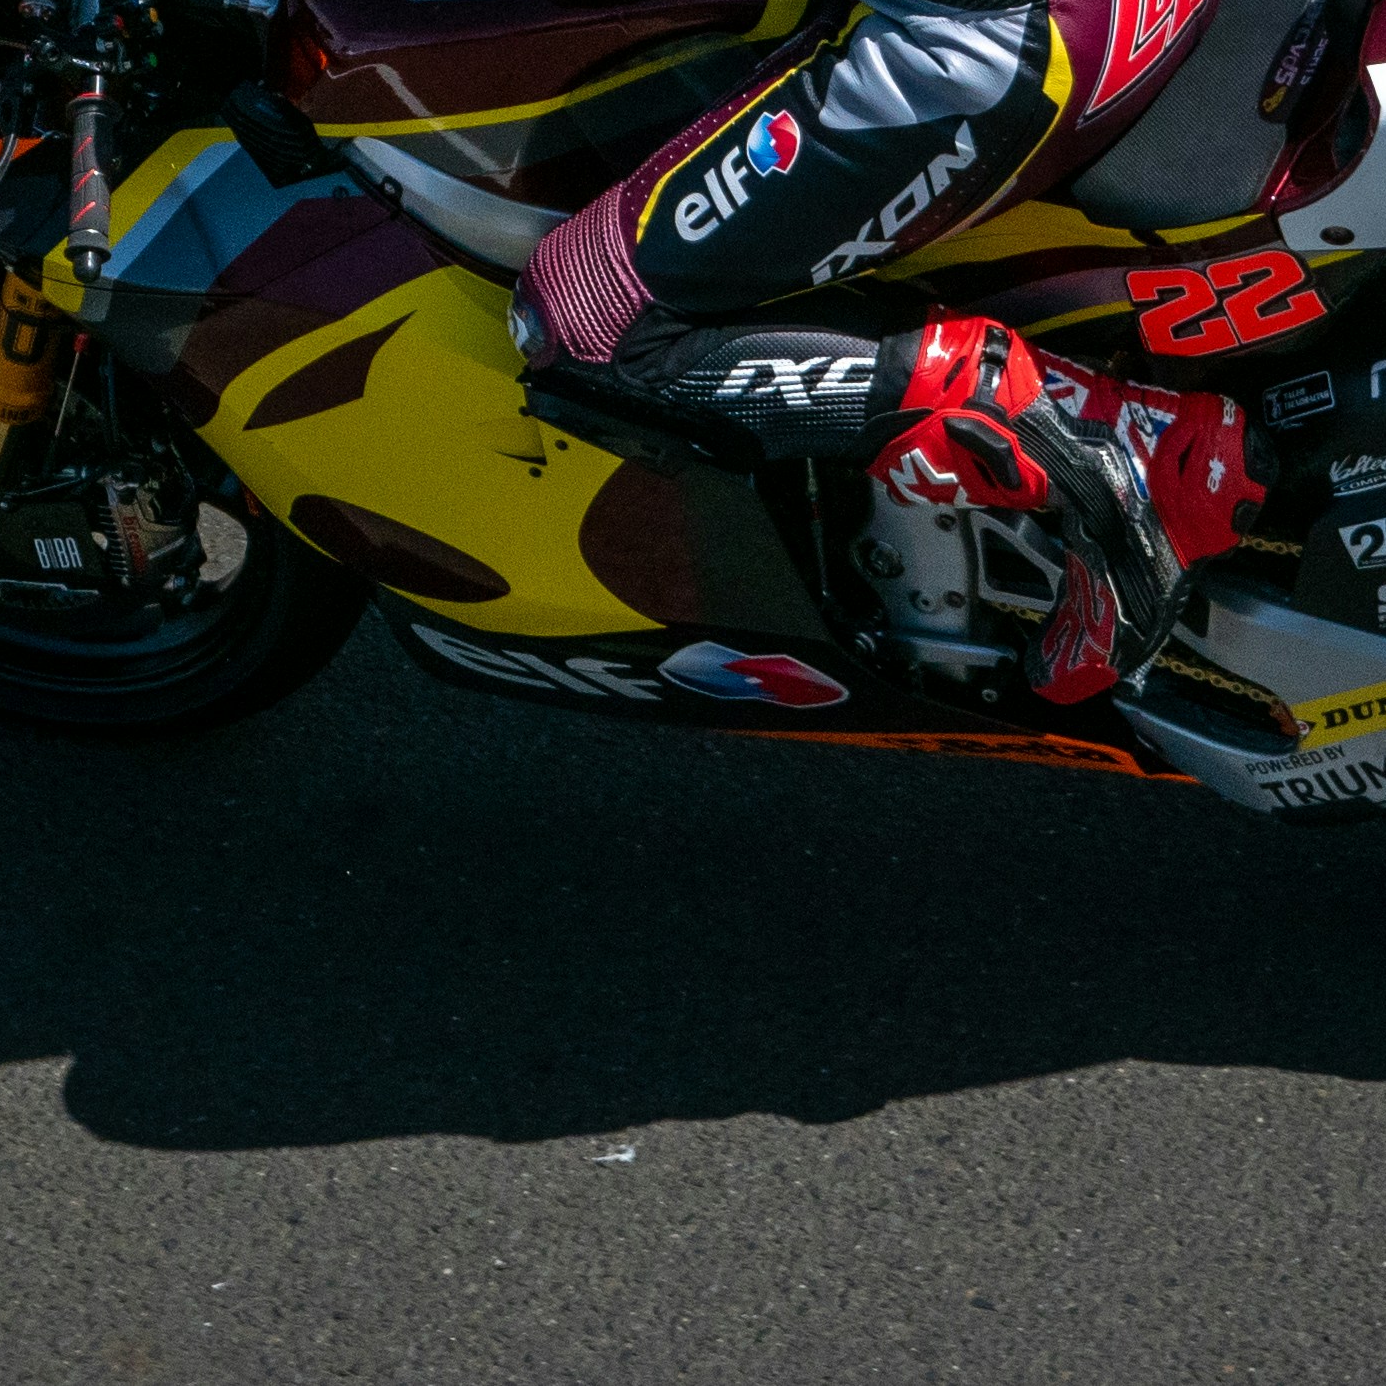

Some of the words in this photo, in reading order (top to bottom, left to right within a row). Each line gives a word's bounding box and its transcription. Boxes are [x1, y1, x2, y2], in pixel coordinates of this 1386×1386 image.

[674, 145, 756, 243] elf
[810, 119, 977, 287] IXON
[1125, 249, 1328, 357] 22
[712, 354, 878, 407] IXO
[411, 623, 664, 701] elf
[1245, 750, 1317, 778] POWERED
[1318, 743, 1346, 765] BY
